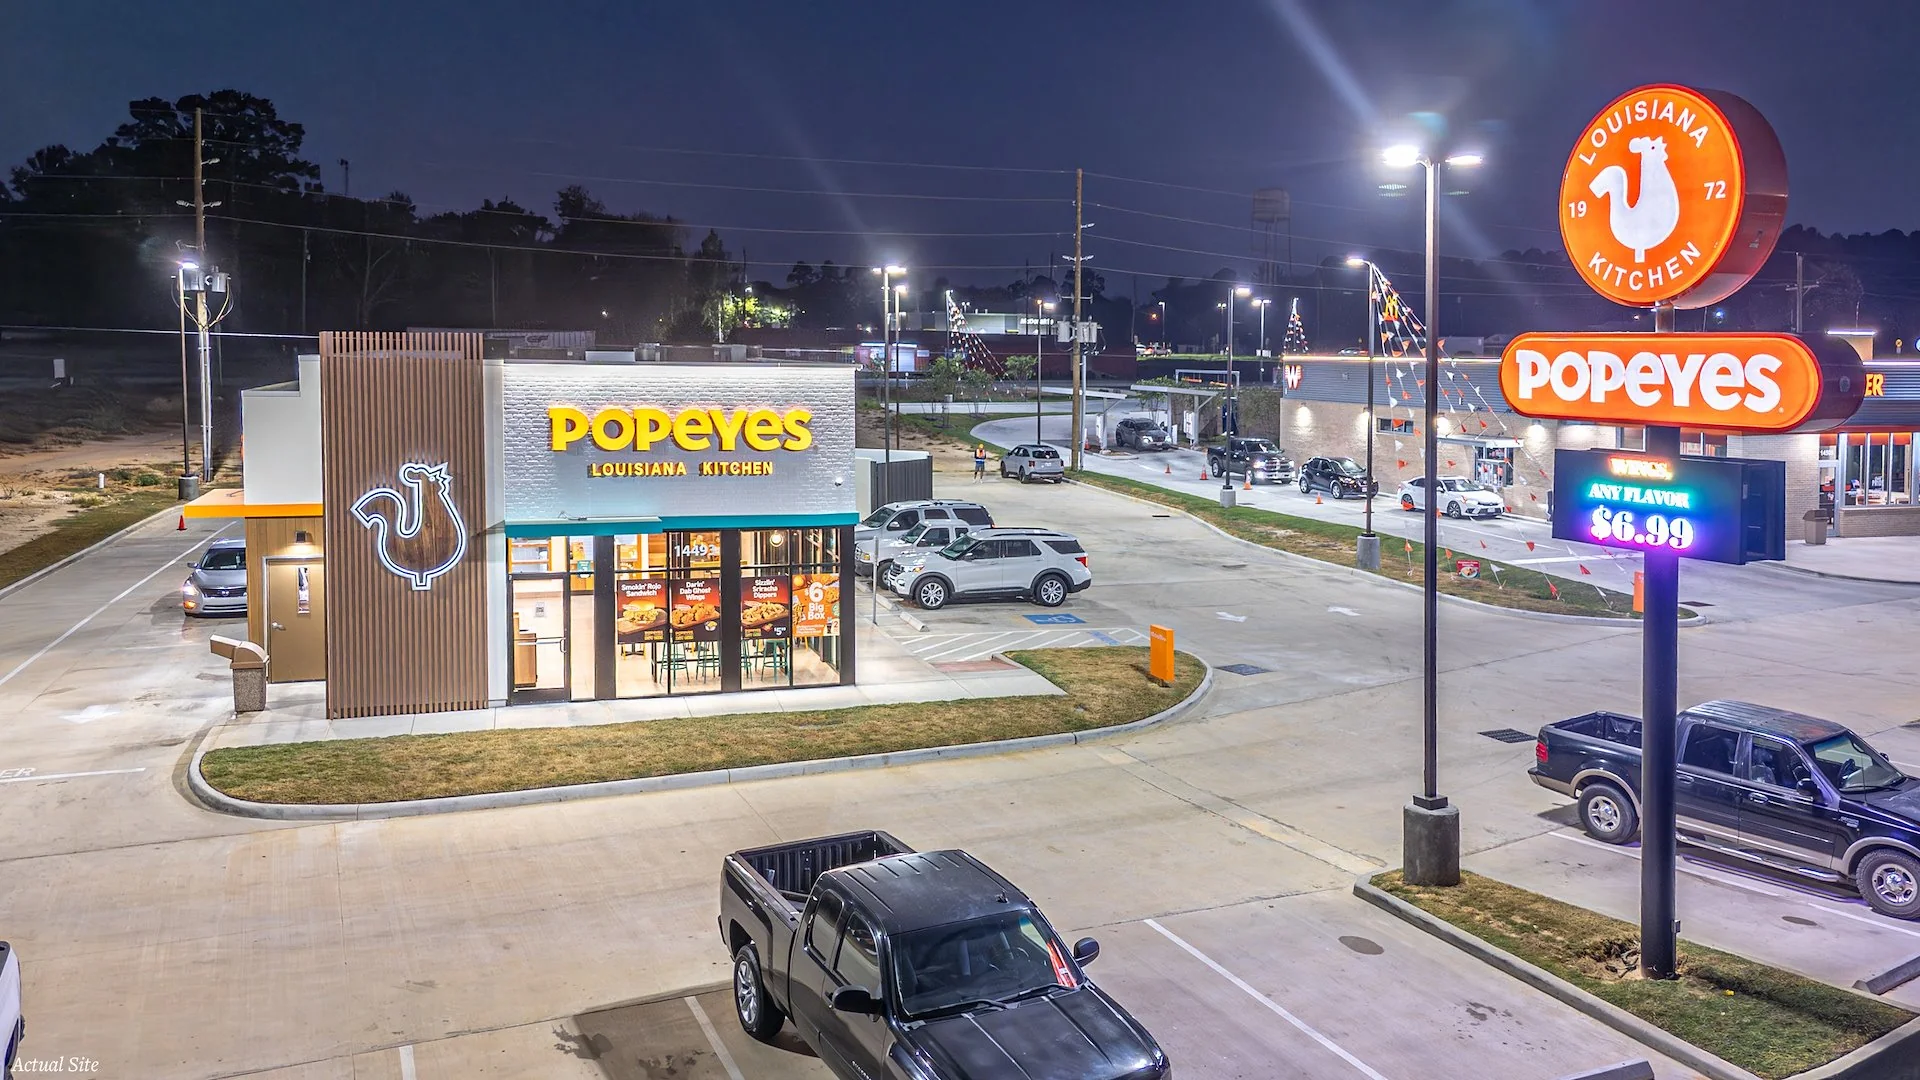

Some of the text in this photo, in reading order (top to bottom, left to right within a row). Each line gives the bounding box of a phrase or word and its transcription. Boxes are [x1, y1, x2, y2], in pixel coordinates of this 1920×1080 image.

[1578, 99, 1709, 166] LOUISIANA
[1703, 180, 1727, 200] 72
[1568, 200, 1588, 219] 19
[1587, 241, 1702, 292] KITCHEN
[1515, 349, 1783, 413] POPEYES
[548, 407, 813, 452] POPEYES
[590, 461, 774, 477] LOUISIANA KITCHEN
[1588, 483, 1690, 509] ANY FLAVOR
[1590, 505, 1694, 549] $6.99
[808, 612, 825, 620] Box
[809, 603, 824, 613] Big
